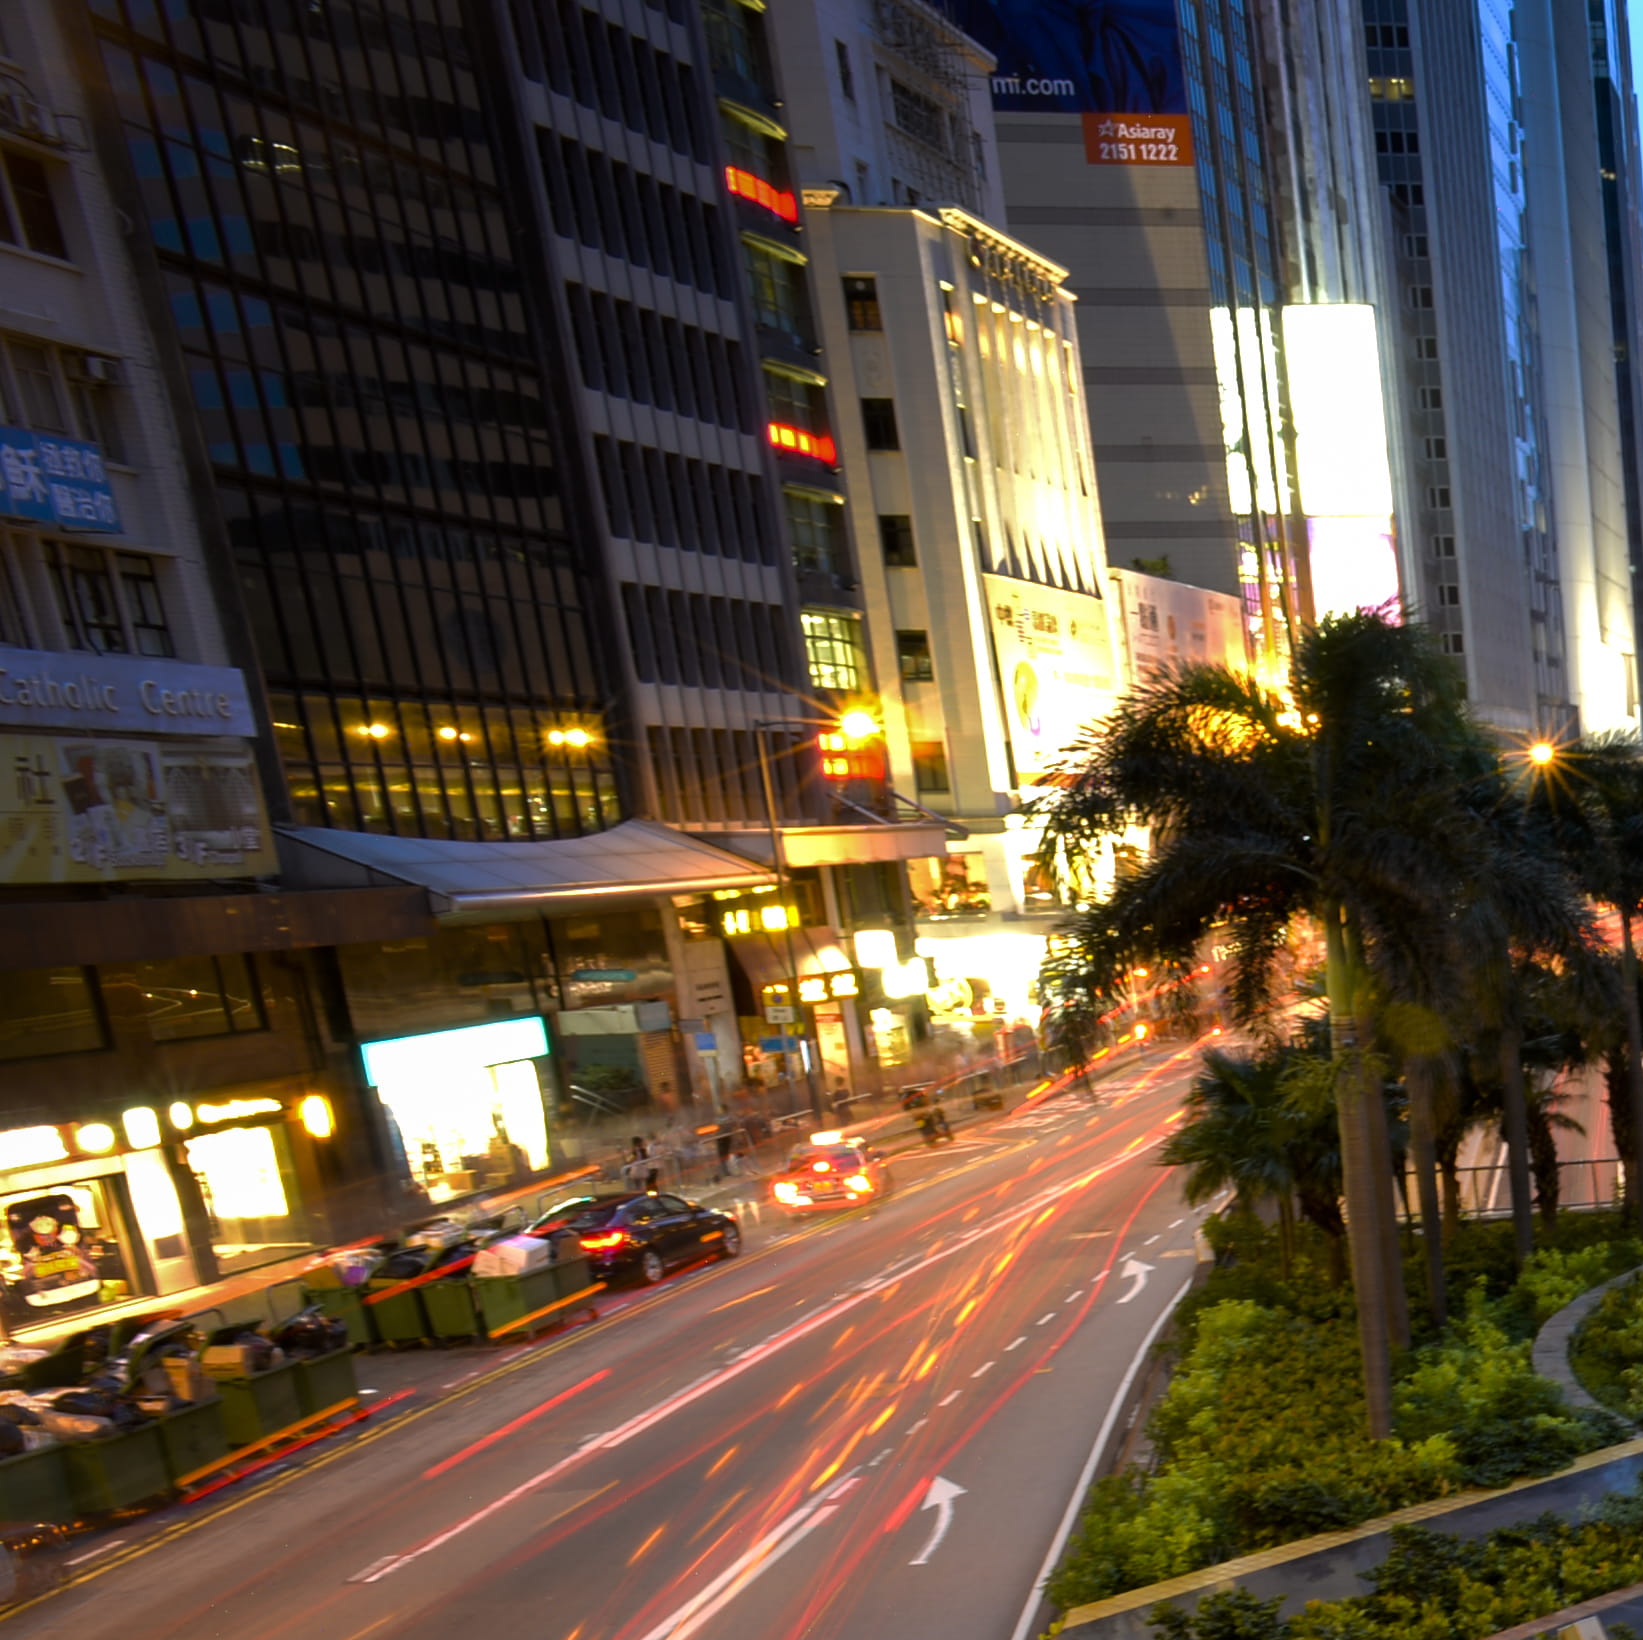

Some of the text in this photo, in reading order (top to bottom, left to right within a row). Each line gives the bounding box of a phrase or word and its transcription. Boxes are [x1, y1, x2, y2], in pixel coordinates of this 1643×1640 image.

[1117, 122, 1176, 142] Asiaray
[1099, 142, 1179, 161] 2151 1222
[140, 679, 232, 719] Centre
